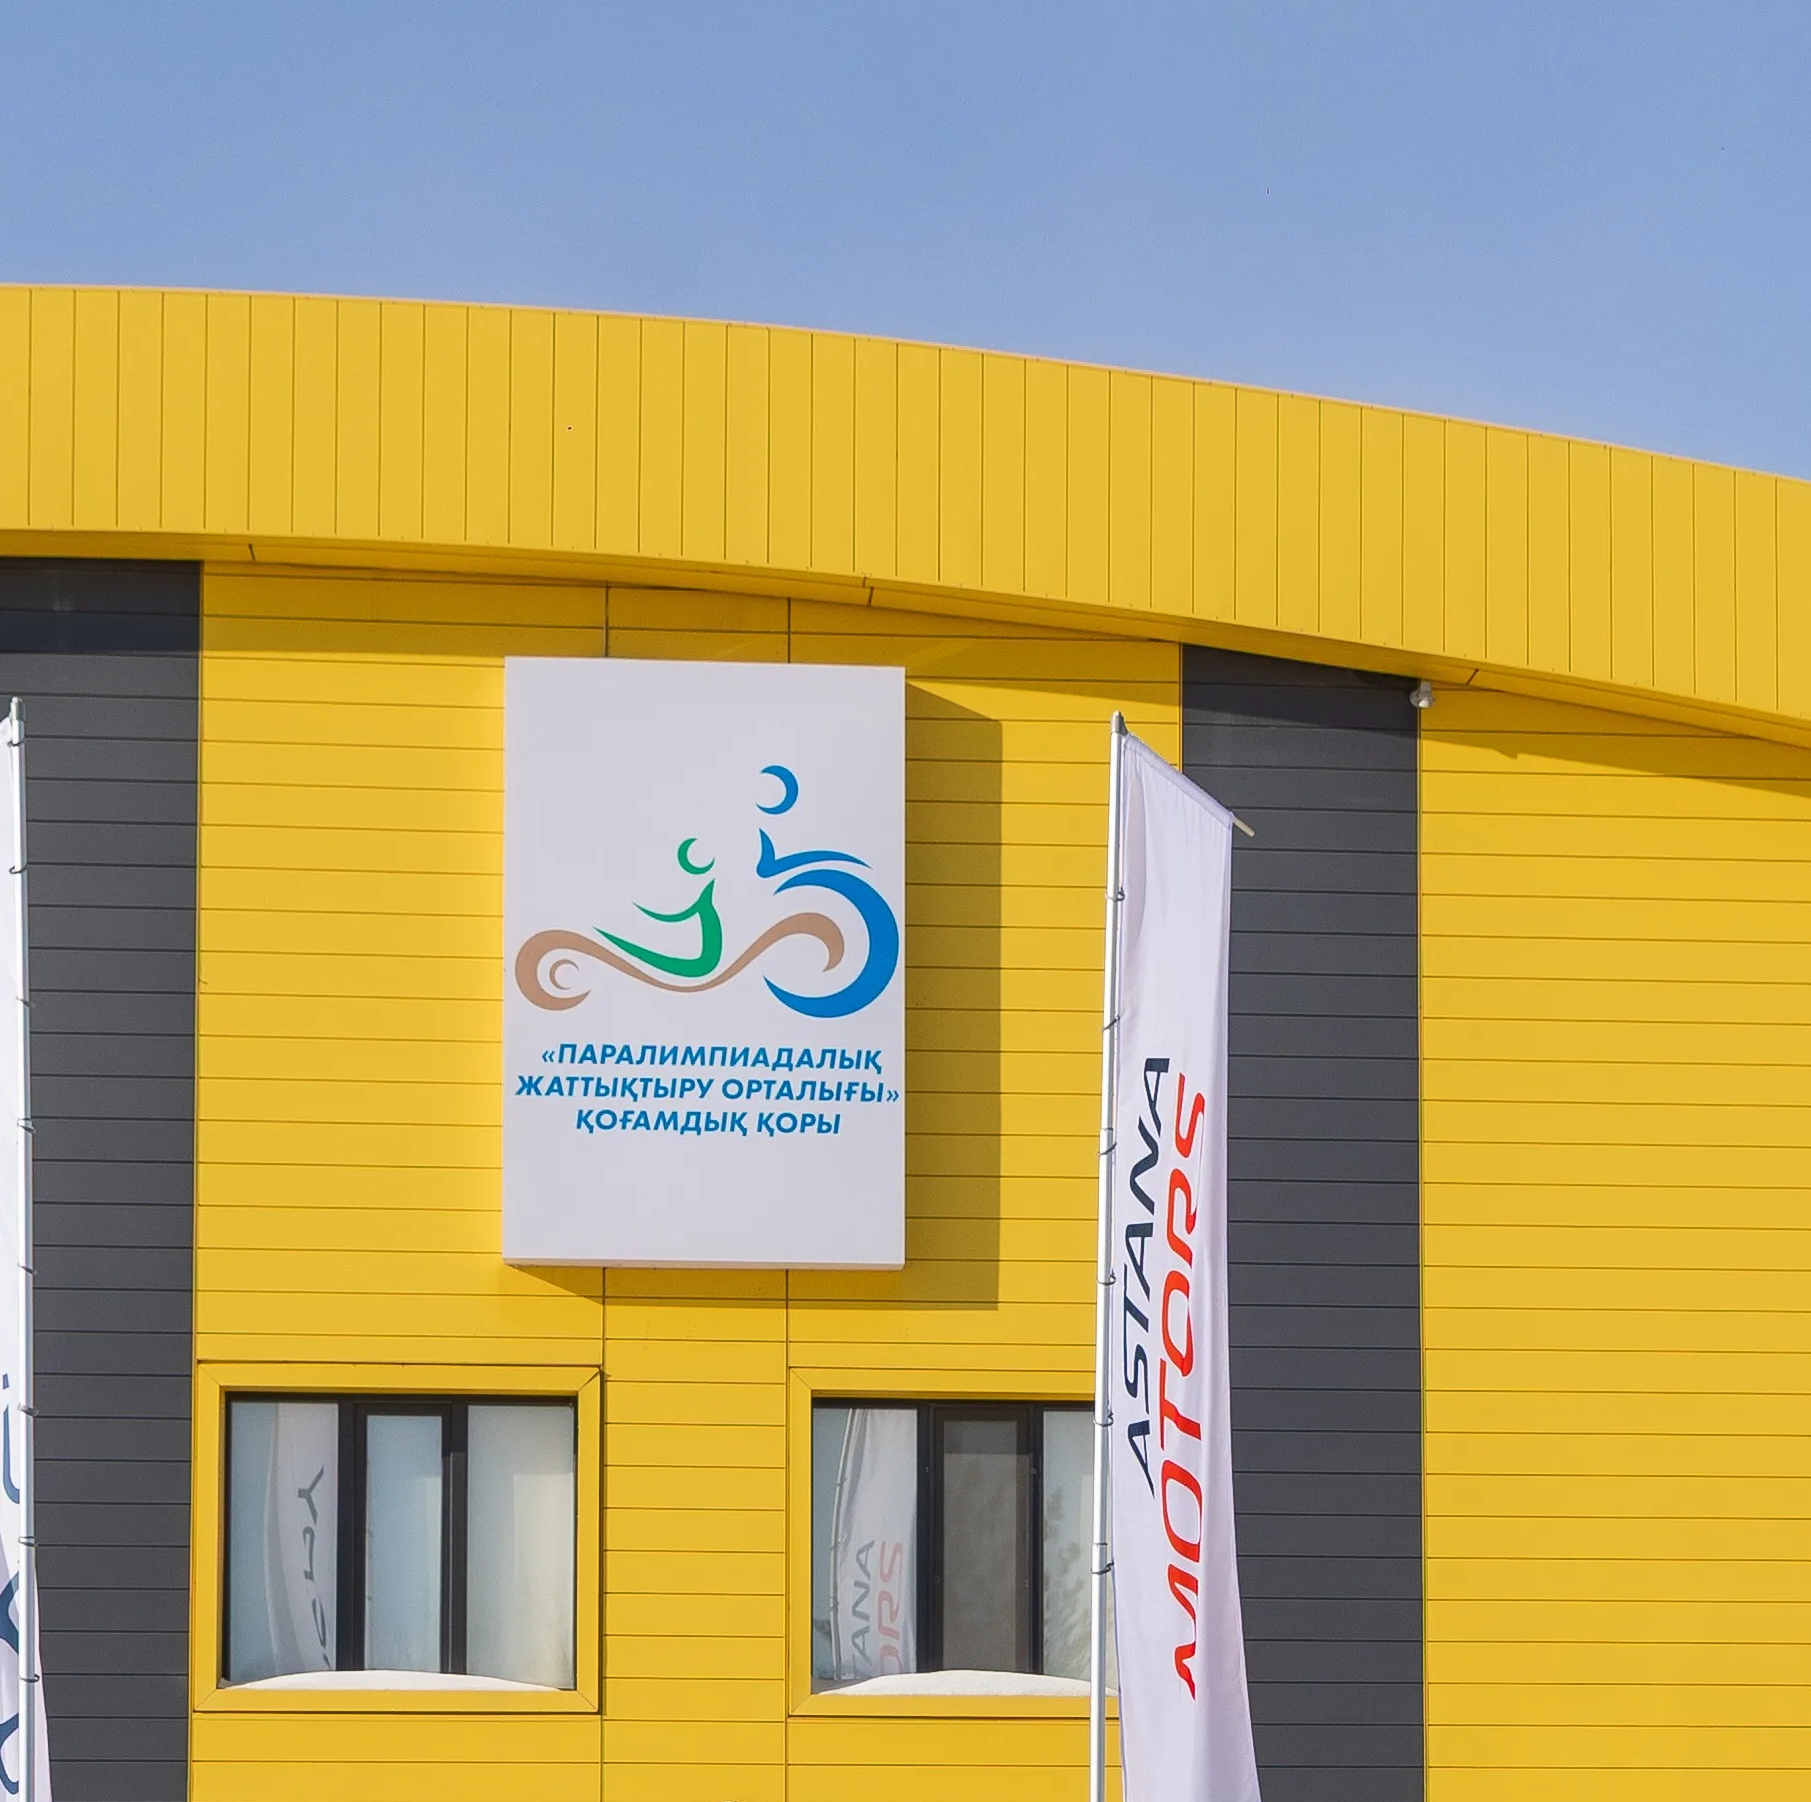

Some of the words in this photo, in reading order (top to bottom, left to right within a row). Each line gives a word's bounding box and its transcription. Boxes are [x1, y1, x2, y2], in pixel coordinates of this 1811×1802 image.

[541, 1043, 883, 1072] «ПАРАЛИМПИАДАЛЫҚ
[515, 1074, 714, 1103] ЖАТТЫҚТЫРУ
[721, 1078, 901, 1105] ОРТАЛЫҒЫ»
[576, 1108, 749, 1137] ҚОҒАМДЫҚ
[756, 1112, 842, 1136] ҚОРЫ
[1122, 1056, 1171, 1499] ASTANA
[1158, 1071, 1207, 1703] MOTORS
